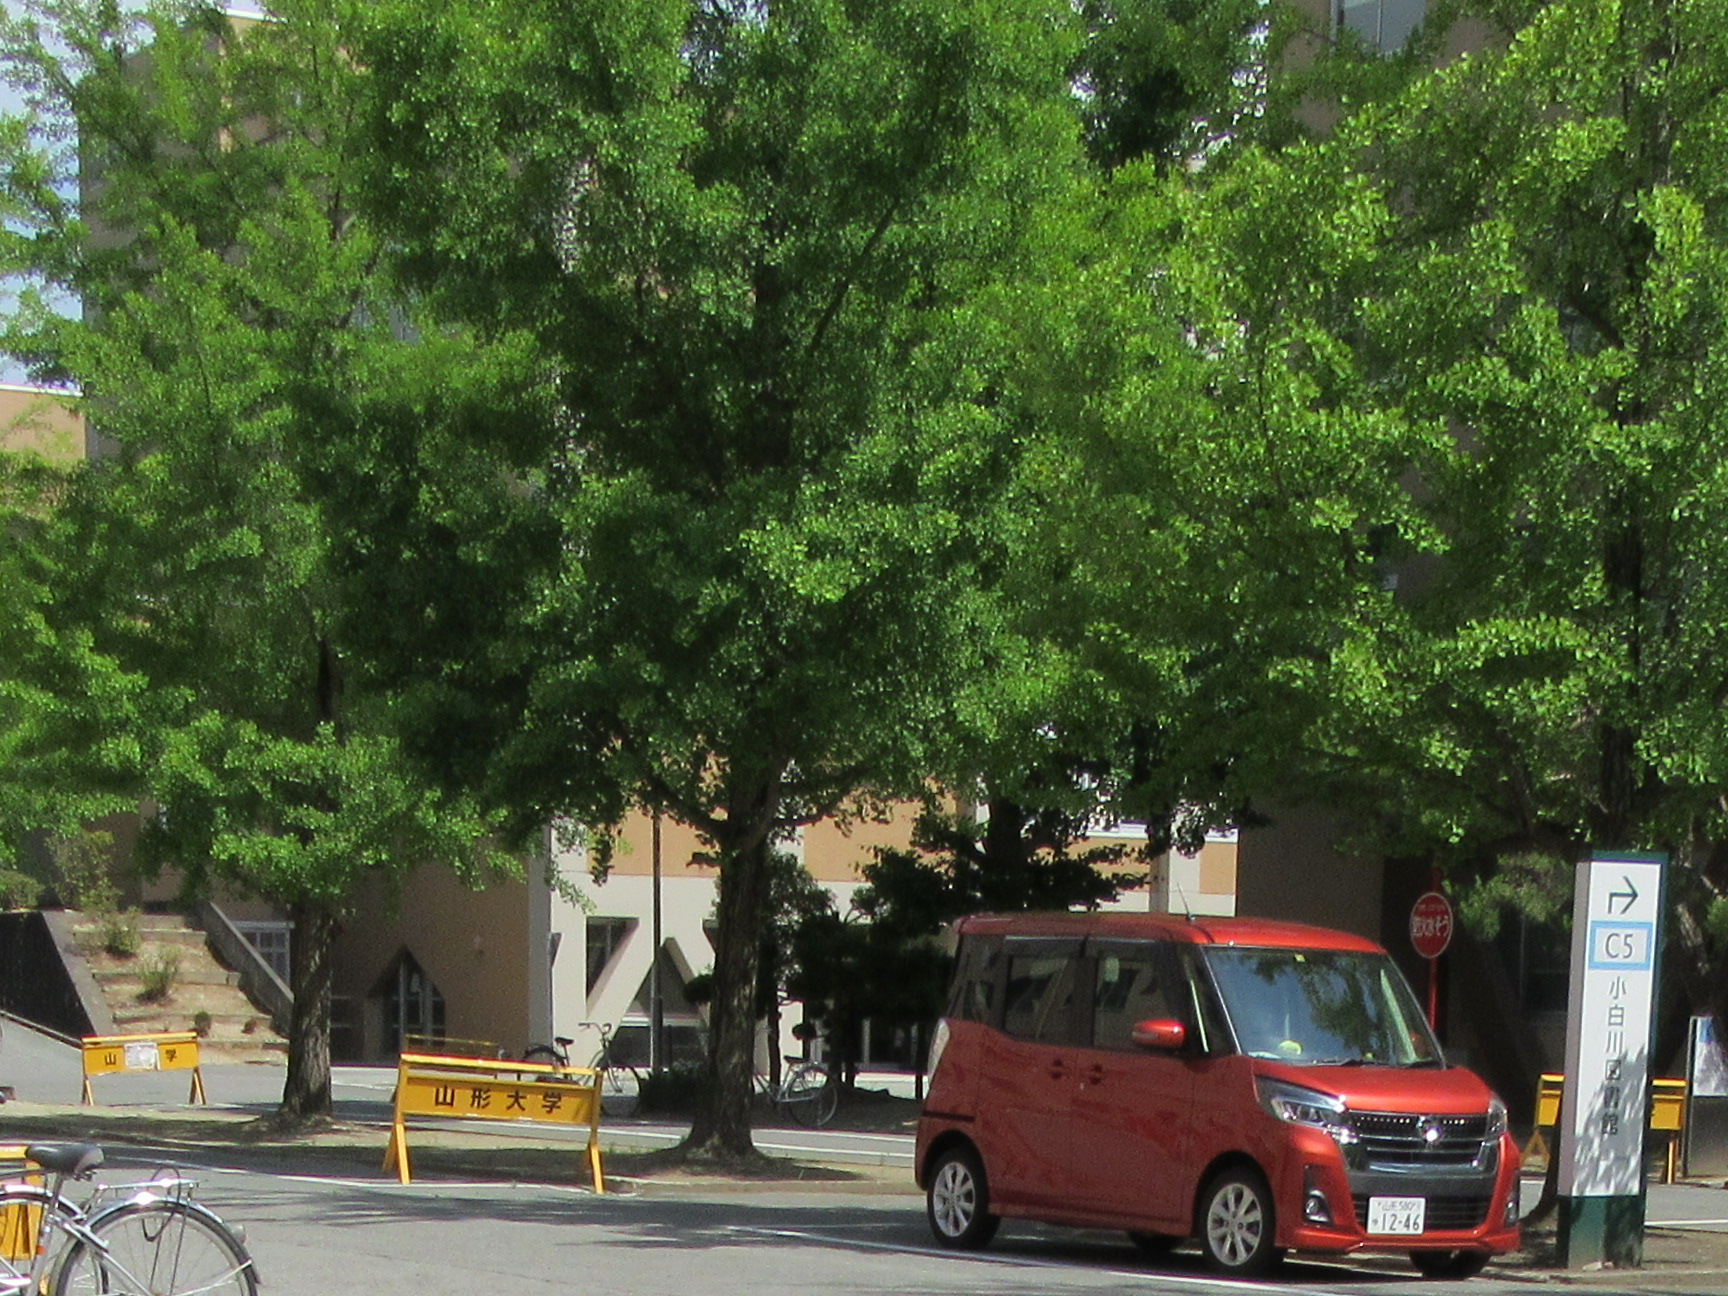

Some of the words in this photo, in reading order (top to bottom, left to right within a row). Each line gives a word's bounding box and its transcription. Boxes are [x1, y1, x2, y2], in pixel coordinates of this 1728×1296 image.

[1605, 932, 1634, 960] C5
[1601, 975, 1628, 1136] 小白川図書館
[434, 1085, 563, 1114] 山形大学
